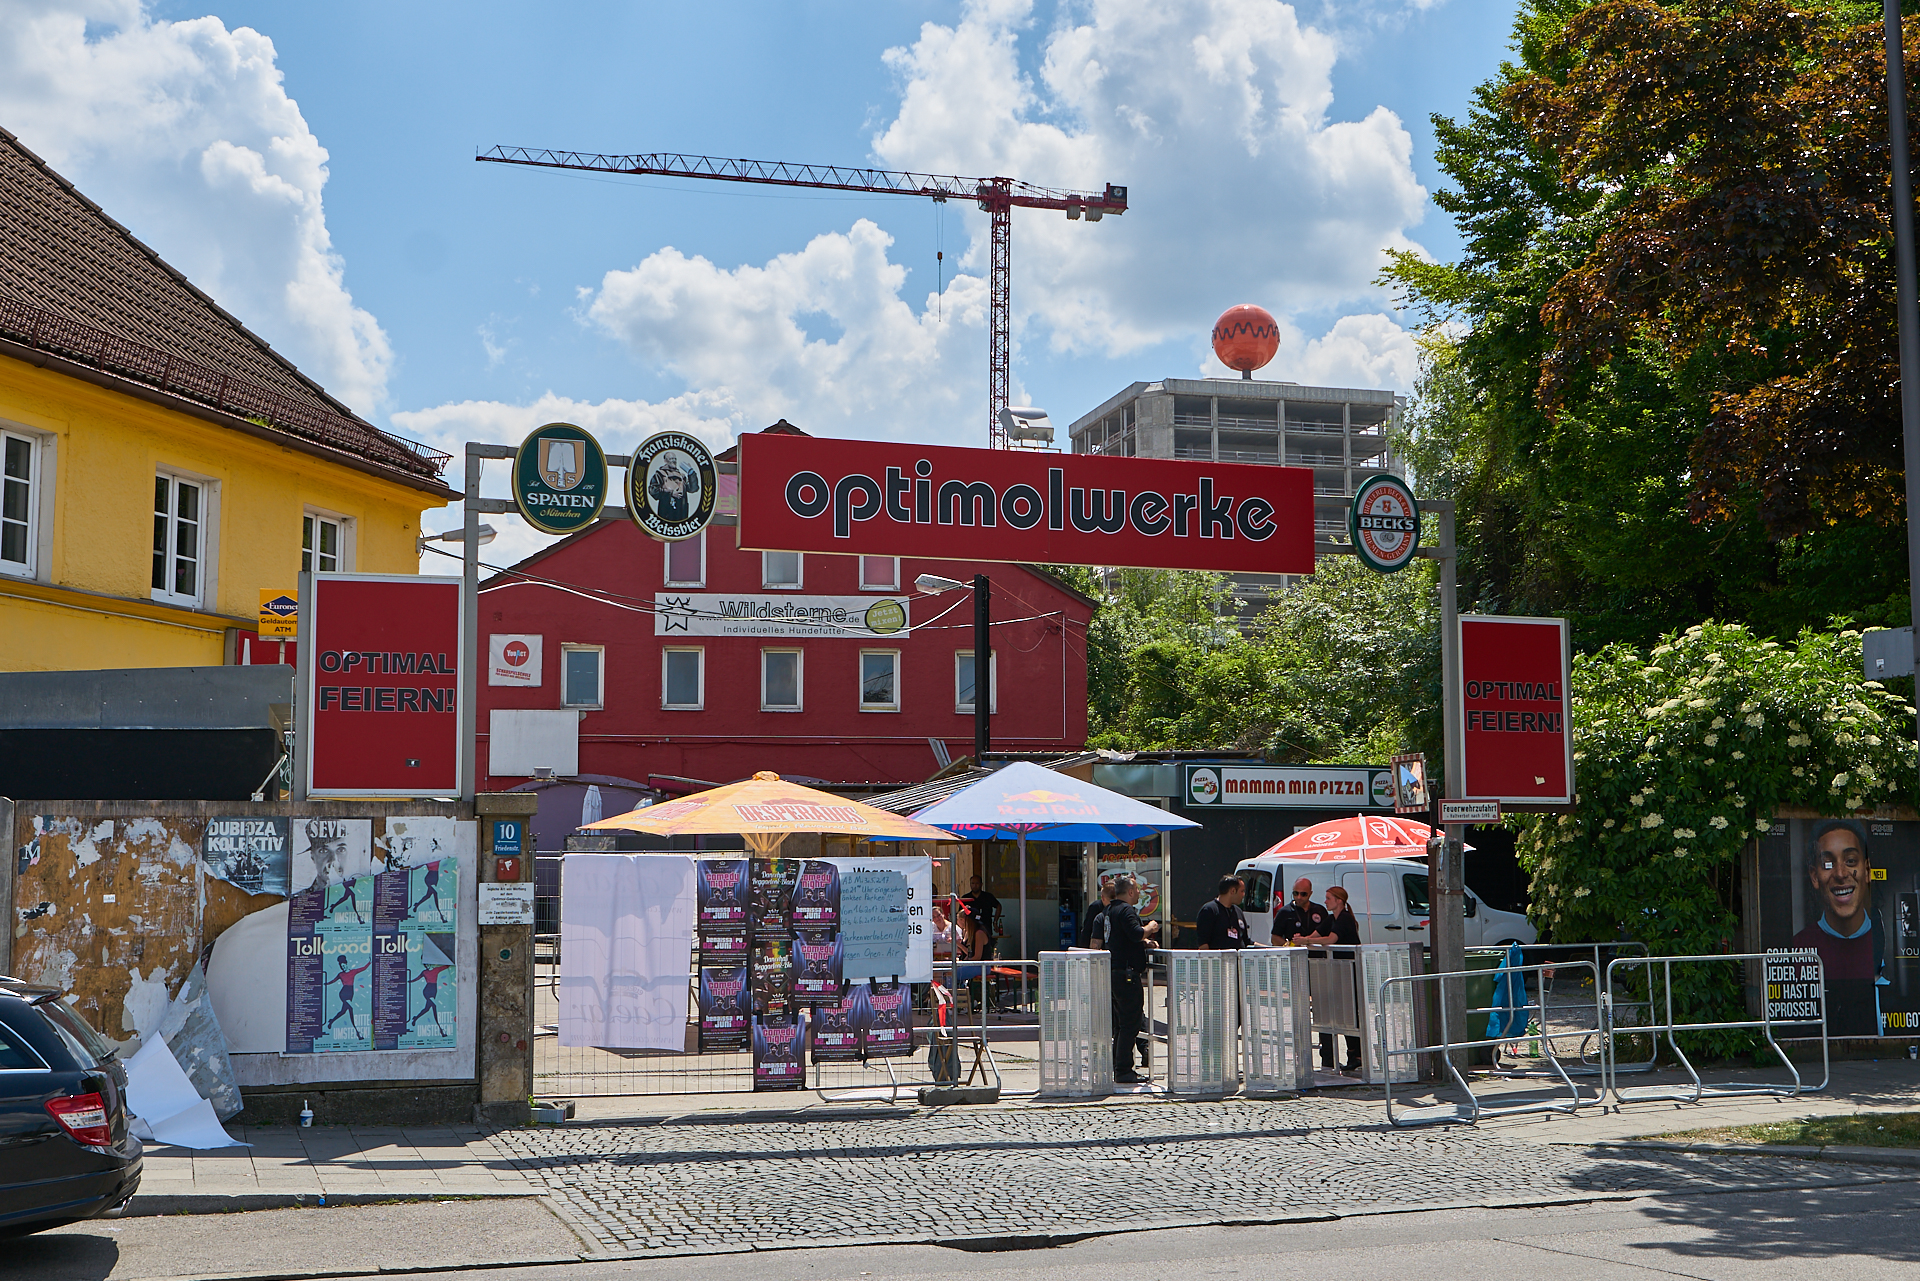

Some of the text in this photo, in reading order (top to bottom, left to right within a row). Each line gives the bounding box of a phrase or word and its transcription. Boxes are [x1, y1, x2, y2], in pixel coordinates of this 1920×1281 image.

[639, 435, 710, 467] Franziskaner
[527, 492, 596, 508] SPATEN
[784, 458, 1278, 542] optimolwerke
[539, 507, 582, 519] München
[645, 513, 702, 537] Weissbier
[1360, 516, 1415, 530] BECK'S
[871, 607, 898, 618] Jetzt
[870, 615, 902, 627] mixen!
[723, 626, 846, 635] Individuelles Hundefutter
[319, 650, 455, 675] OPTIMAL
[1466, 679, 1561, 702] OPTIMAL
[319, 686, 455, 713] FEIERN!
[1466, 709, 1562, 734] FEIERN!
[1225, 779, 1364, 795] MAMMA MIA PIZZA
[734, 804, 866, 824] DESPERADOS
[996, 804, 1100, 816] Red Bull
[1443, 804, 1497, 812] Feuerwehrzufahrt
[208, 821, 277, 836] DUBIOZA
[500, 823, 515, 840] 10
[208, 836, 284, 852] KOLEKTIV
[495, 844, 520, 852] Friedenstr.
[1303, 841, 1335, 849] LANGNESE
[1102, 850, 1148, 863] service
[706, 872, 740, 884] comedy
[1873, 870, 1884, 879] NEU
[710, 880, 734, 889] night
[801, 880, 826, 889] night
[290, 935, 371, 956] Tollwood
[801, 944, 835, 956] comedy
[886, 946, 901, 957] Air
[804, 952, 829, 961] night
[1767, 965, 1821, 983] JEDER, ABE
[708, 980, 742, 992] comedy
[823, 983, 839, 991] 2017
[1768, 983, 1822, 999] DU HAST DI
[712, 988, 736, 997] night
[869, 993, 903, 1005] comedy
[873, 1001, 898, 1011] night
[1768, 1001, 1820, 1018] SPROSSEN.
[762, 1026, 796, 1038] comedy
[894, 1032, 910, 1040] 2017
[766, 1034, 791, 1044] night
[842, 1037, 859, 1045] 2017
